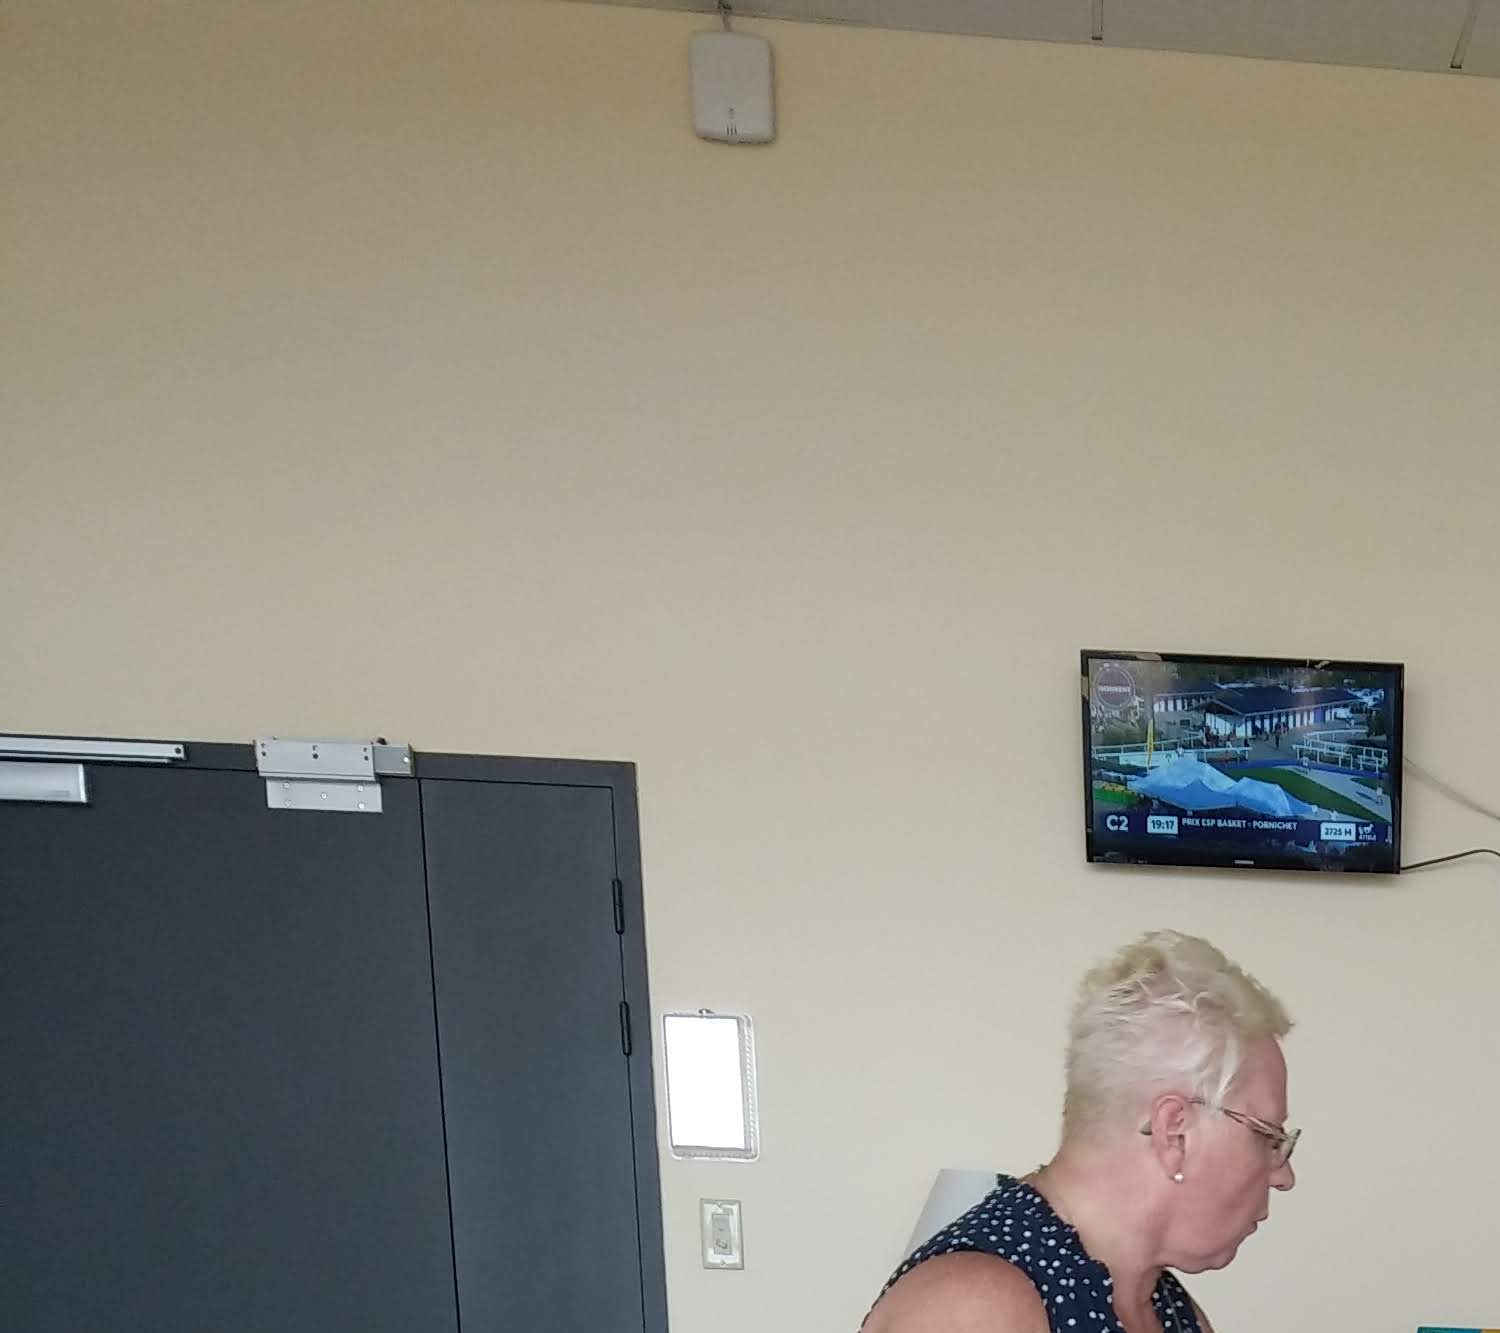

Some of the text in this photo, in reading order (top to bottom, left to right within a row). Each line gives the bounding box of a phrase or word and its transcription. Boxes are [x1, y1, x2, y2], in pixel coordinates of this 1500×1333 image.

[1106, 814, 1128, 831] C2
[1151, 819, 1175, 830] 19:17
[1182, 817, 1200, 826] PRIX
[1201, 818, 1215, 827] ESP
[1217, 819, 1246, 829] BASKET
[1253, 821, 1297, 831] PORNICHET
